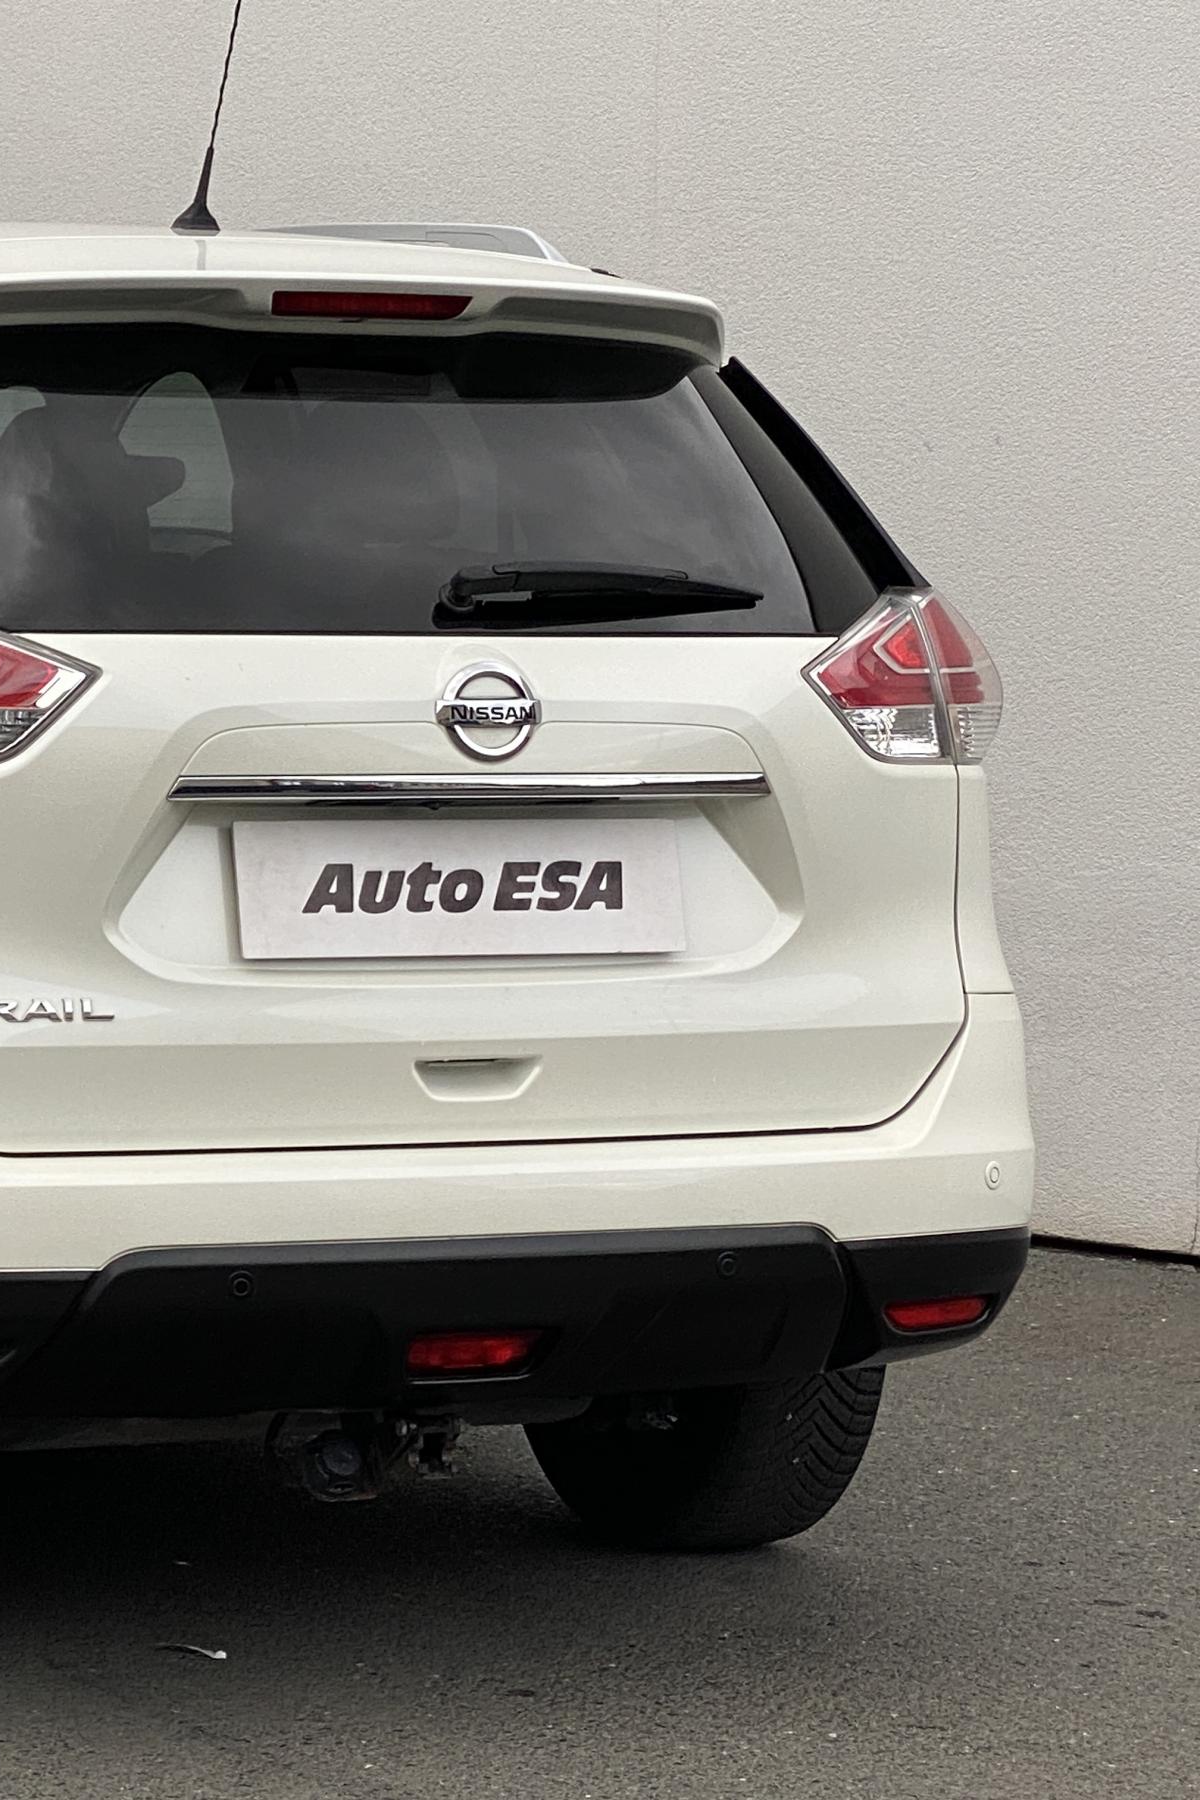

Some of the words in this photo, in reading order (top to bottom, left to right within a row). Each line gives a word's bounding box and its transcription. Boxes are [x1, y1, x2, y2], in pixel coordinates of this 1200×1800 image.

[451, 706, 537, 720] NISSAN
[302, 862, 484, 914] Auto
[494, 860, 624, 911] ESA
